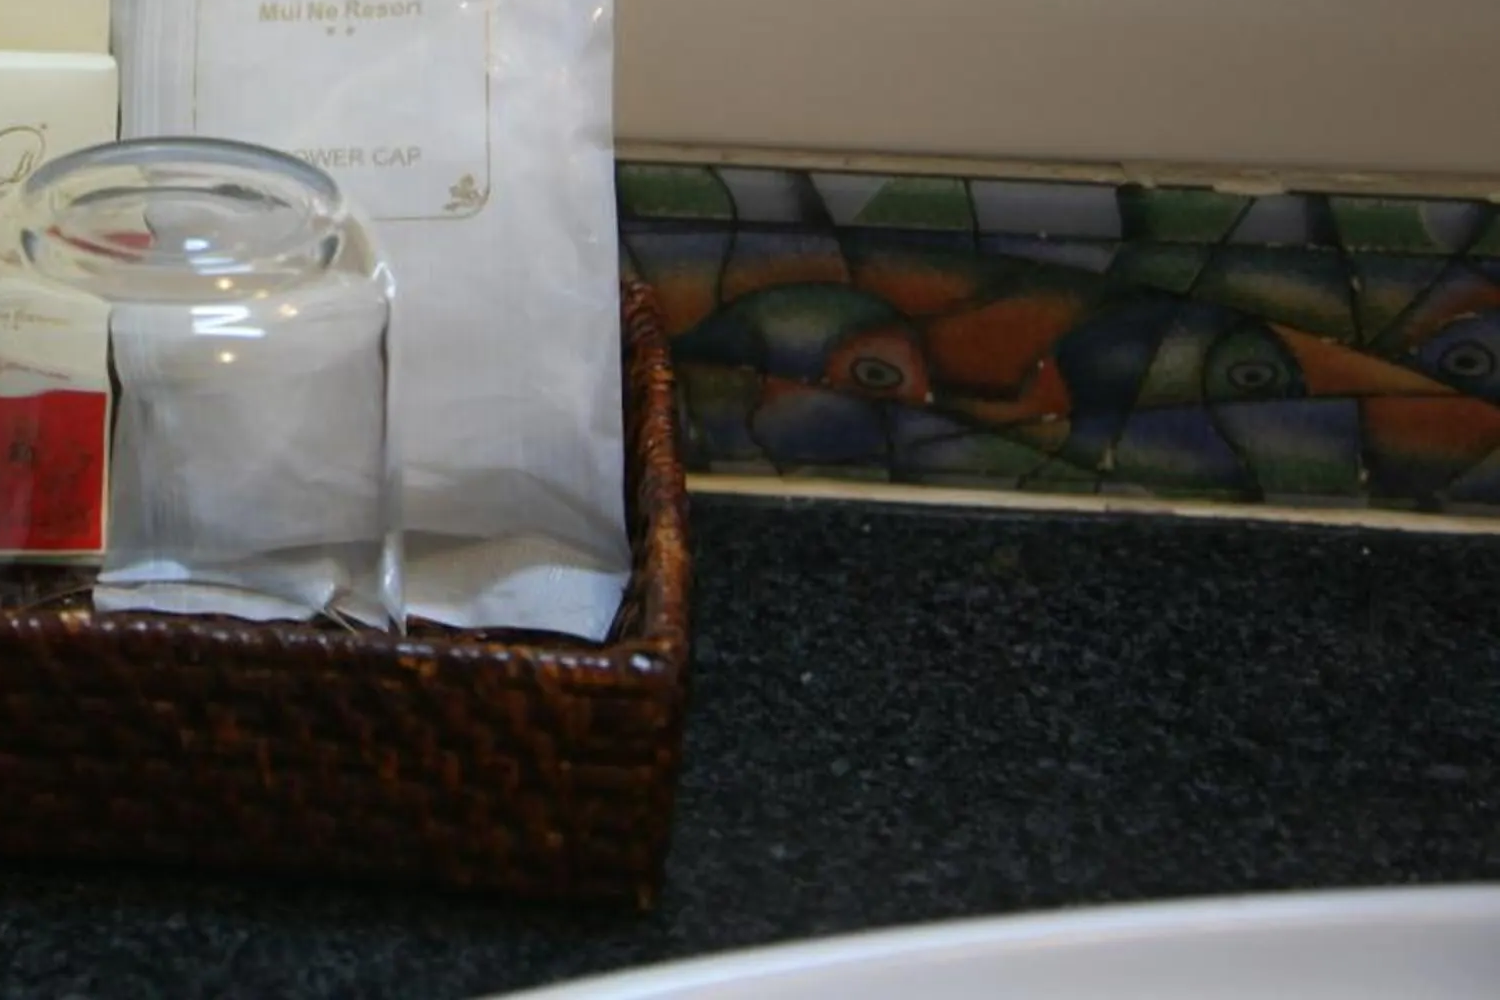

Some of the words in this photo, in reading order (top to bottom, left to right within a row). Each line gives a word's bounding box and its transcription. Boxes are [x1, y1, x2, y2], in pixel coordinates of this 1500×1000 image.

[258, 1, 302, 22] Mui
[307, 1, 338, 21] Ne
[293, 147, 365, 168] OWER
[372, 146, 421, 168] CAP
